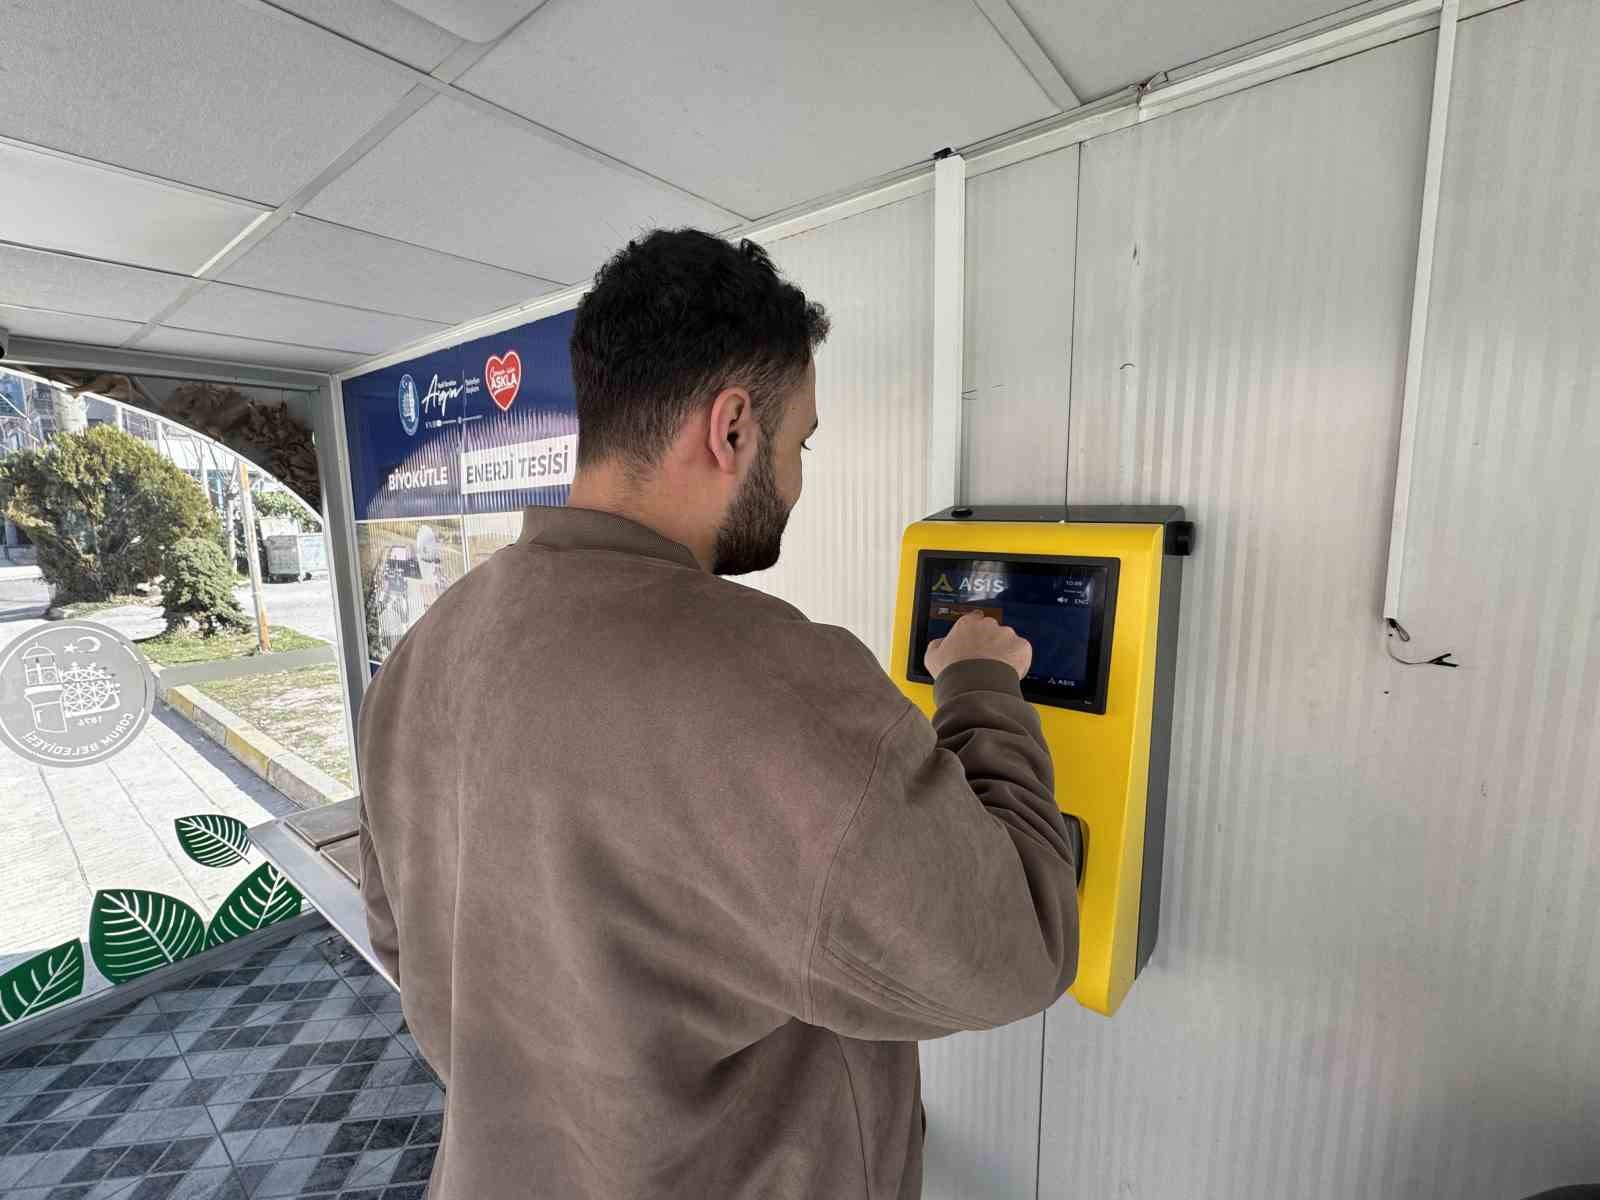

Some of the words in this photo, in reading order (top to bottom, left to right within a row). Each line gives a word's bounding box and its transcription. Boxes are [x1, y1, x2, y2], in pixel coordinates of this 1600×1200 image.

[388, 464, 448, 491] BİYOKÜTLE
[466, 452, 514, 484] ENERJİ
[518, 444, 568, 478] TESİSİ
